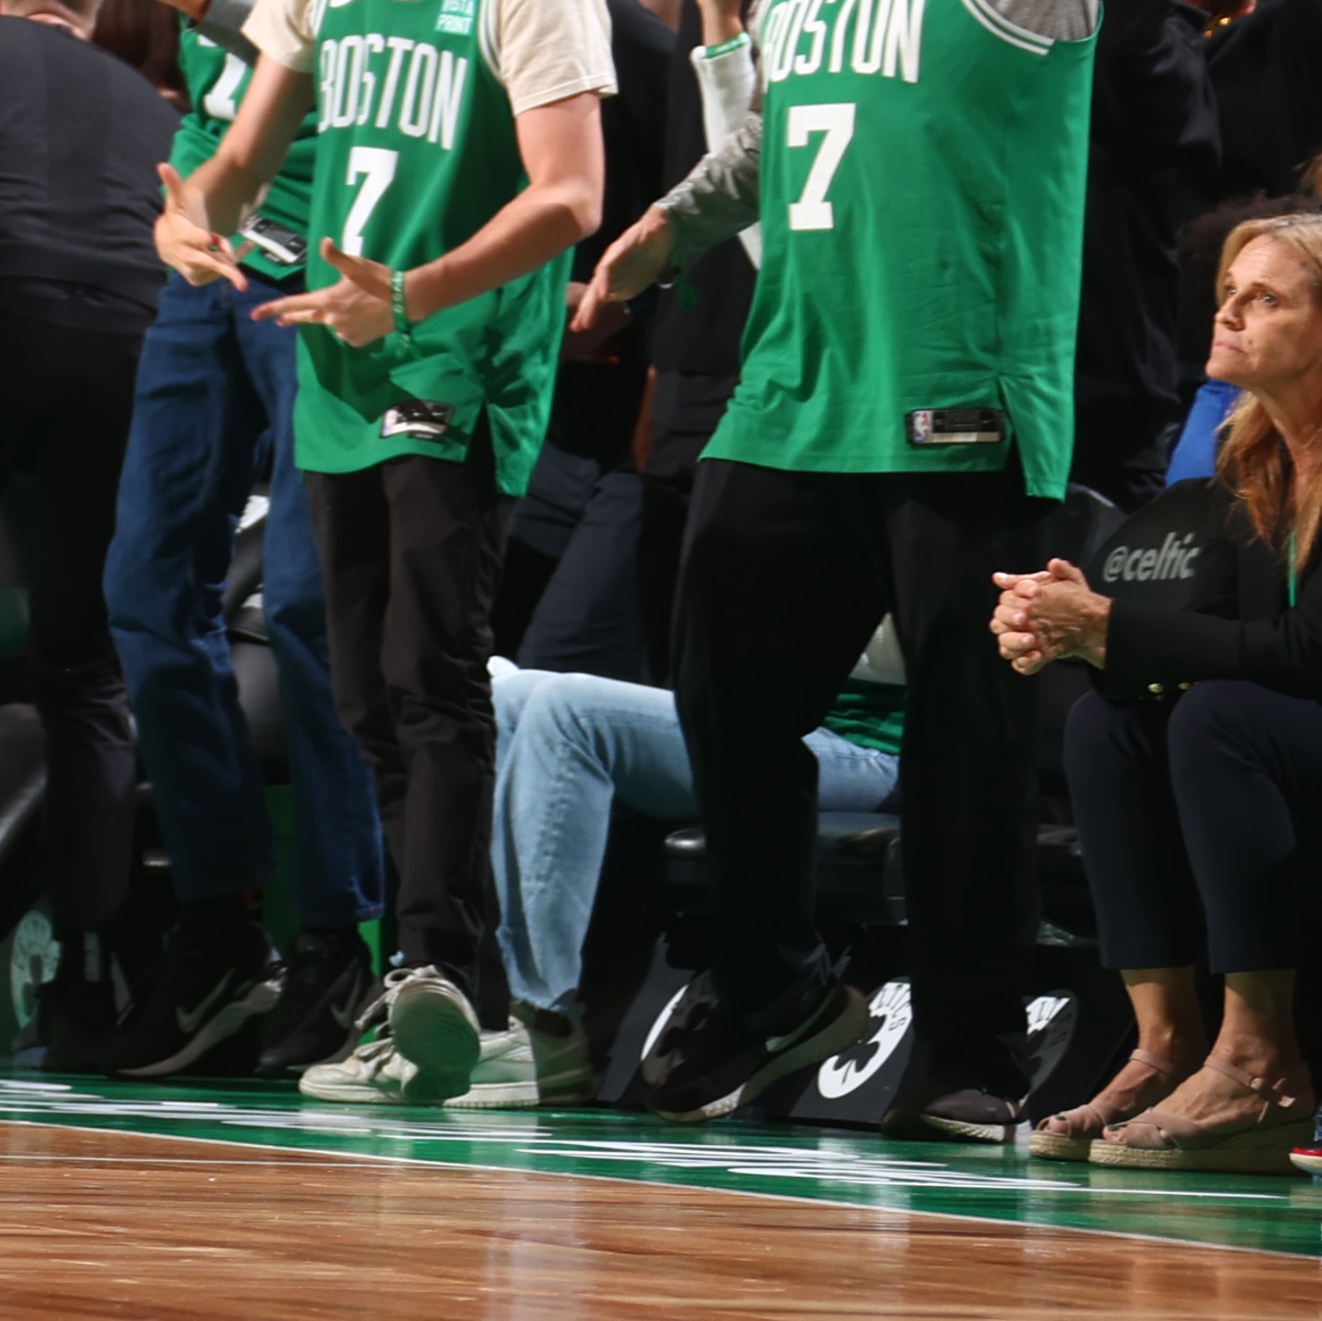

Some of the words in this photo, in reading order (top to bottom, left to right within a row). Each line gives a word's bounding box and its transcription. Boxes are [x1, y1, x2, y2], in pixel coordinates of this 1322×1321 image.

[434, 13, 474, 36] PRINT
[317, 33, 468, 151] BOSTON
[342, 145, 399, 258] 7
[785, 102, 856, 231] 7
